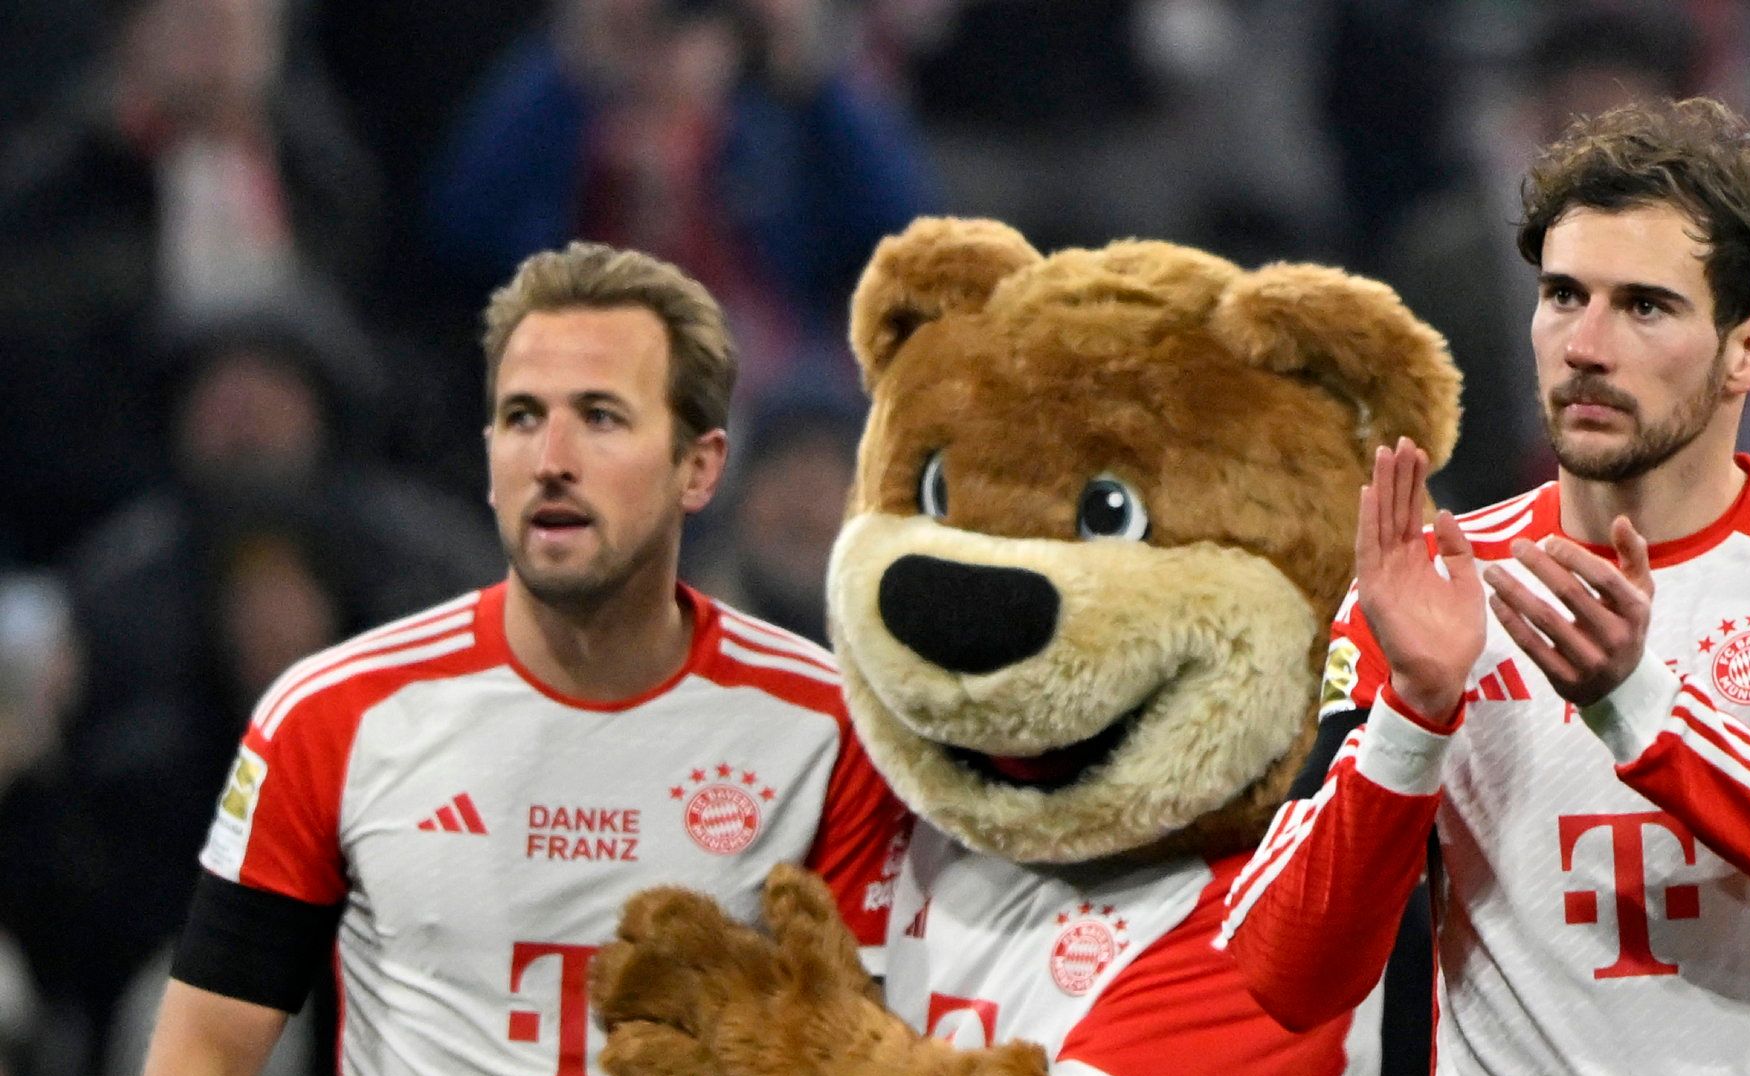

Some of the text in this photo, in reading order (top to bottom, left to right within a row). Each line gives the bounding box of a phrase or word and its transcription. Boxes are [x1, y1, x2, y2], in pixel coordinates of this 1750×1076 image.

[528, 805, 641, 834] DANKE
[526, 833, 640, 862] FRANZ
[1557, 811, 1701, 981] T
